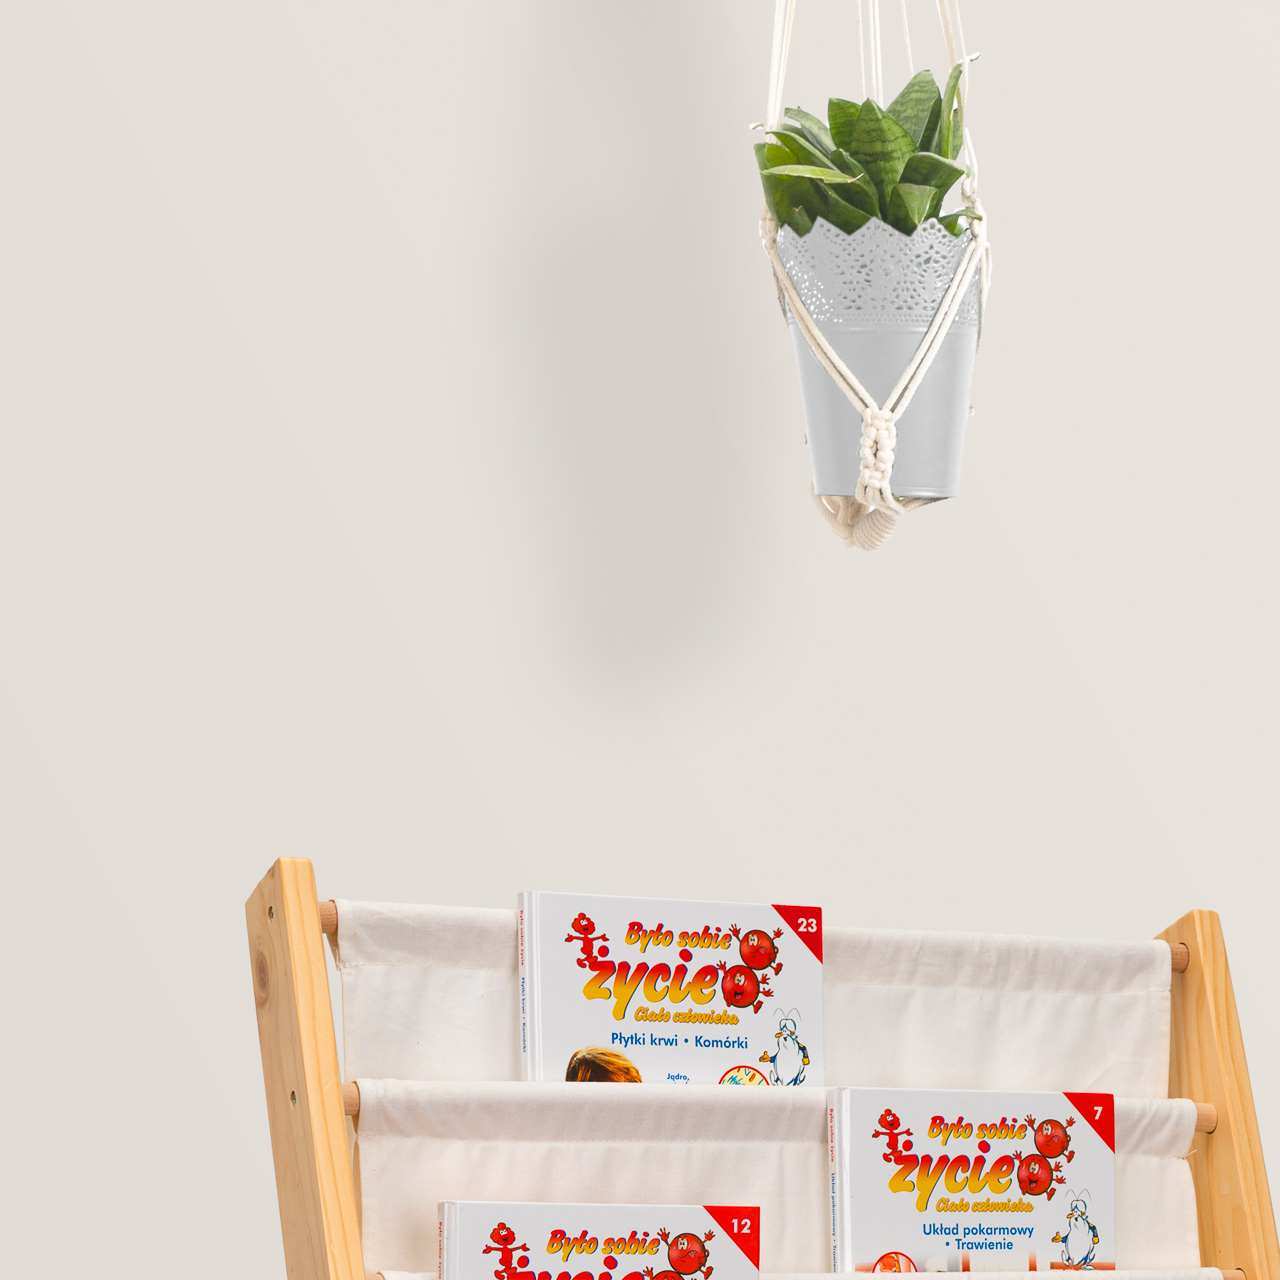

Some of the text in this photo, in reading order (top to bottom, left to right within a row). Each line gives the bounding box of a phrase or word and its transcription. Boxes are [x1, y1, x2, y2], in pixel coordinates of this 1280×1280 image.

[797, 917, 817, 933] 23
[625, 921, 732, 953] Było sobie
[583, 945, 720, 1021] życie
[634, 1006, 739, 1026] Ciało człowieka
[611, 1032, 748, 1049] Płytki krwi Komórki
[1093, 1106, 1103, 1120] 7
[927, 1115, 1027, 1146] Było sobie
[888, 1139, 1016, 1212] życie
[936, 1197, 1034, 1213] Ciało człowieka
[731, 1218, 751, 1234] 12
[923, 1223, 1034, 1239] Układ pokarmowy
[546, 1229, 659, 1262] Było sobie
[955, 1238, 1014, 1250] Trawienie
